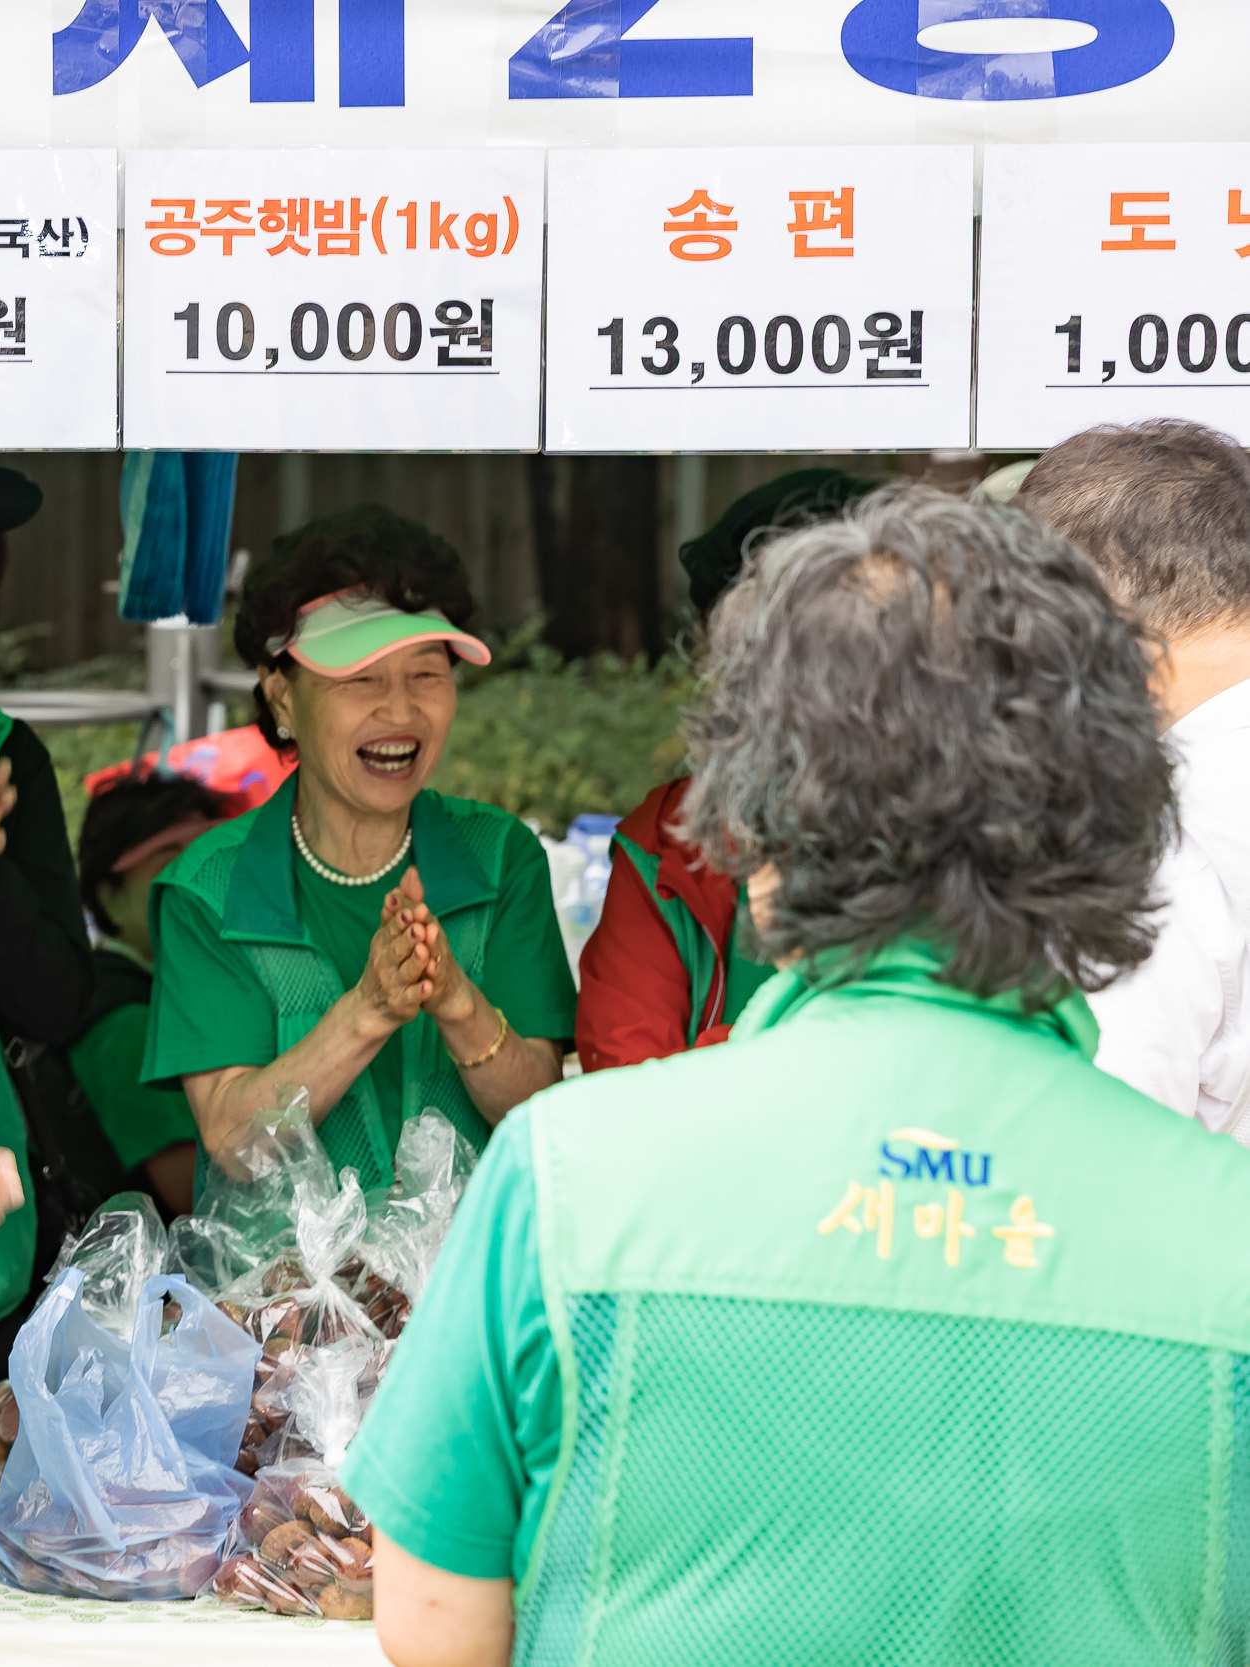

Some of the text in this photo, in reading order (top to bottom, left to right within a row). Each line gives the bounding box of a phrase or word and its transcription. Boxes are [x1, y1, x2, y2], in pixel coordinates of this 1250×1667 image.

[145, 196, 519, 258] 공주햇밤(1kg)
[175, 299, 493, 369] 10,000원
[598, 311, 923, 384] 13,000원
[880, 1141, 992, 1188] SMU
[817, 1180, 1054, 1267] 새마을
